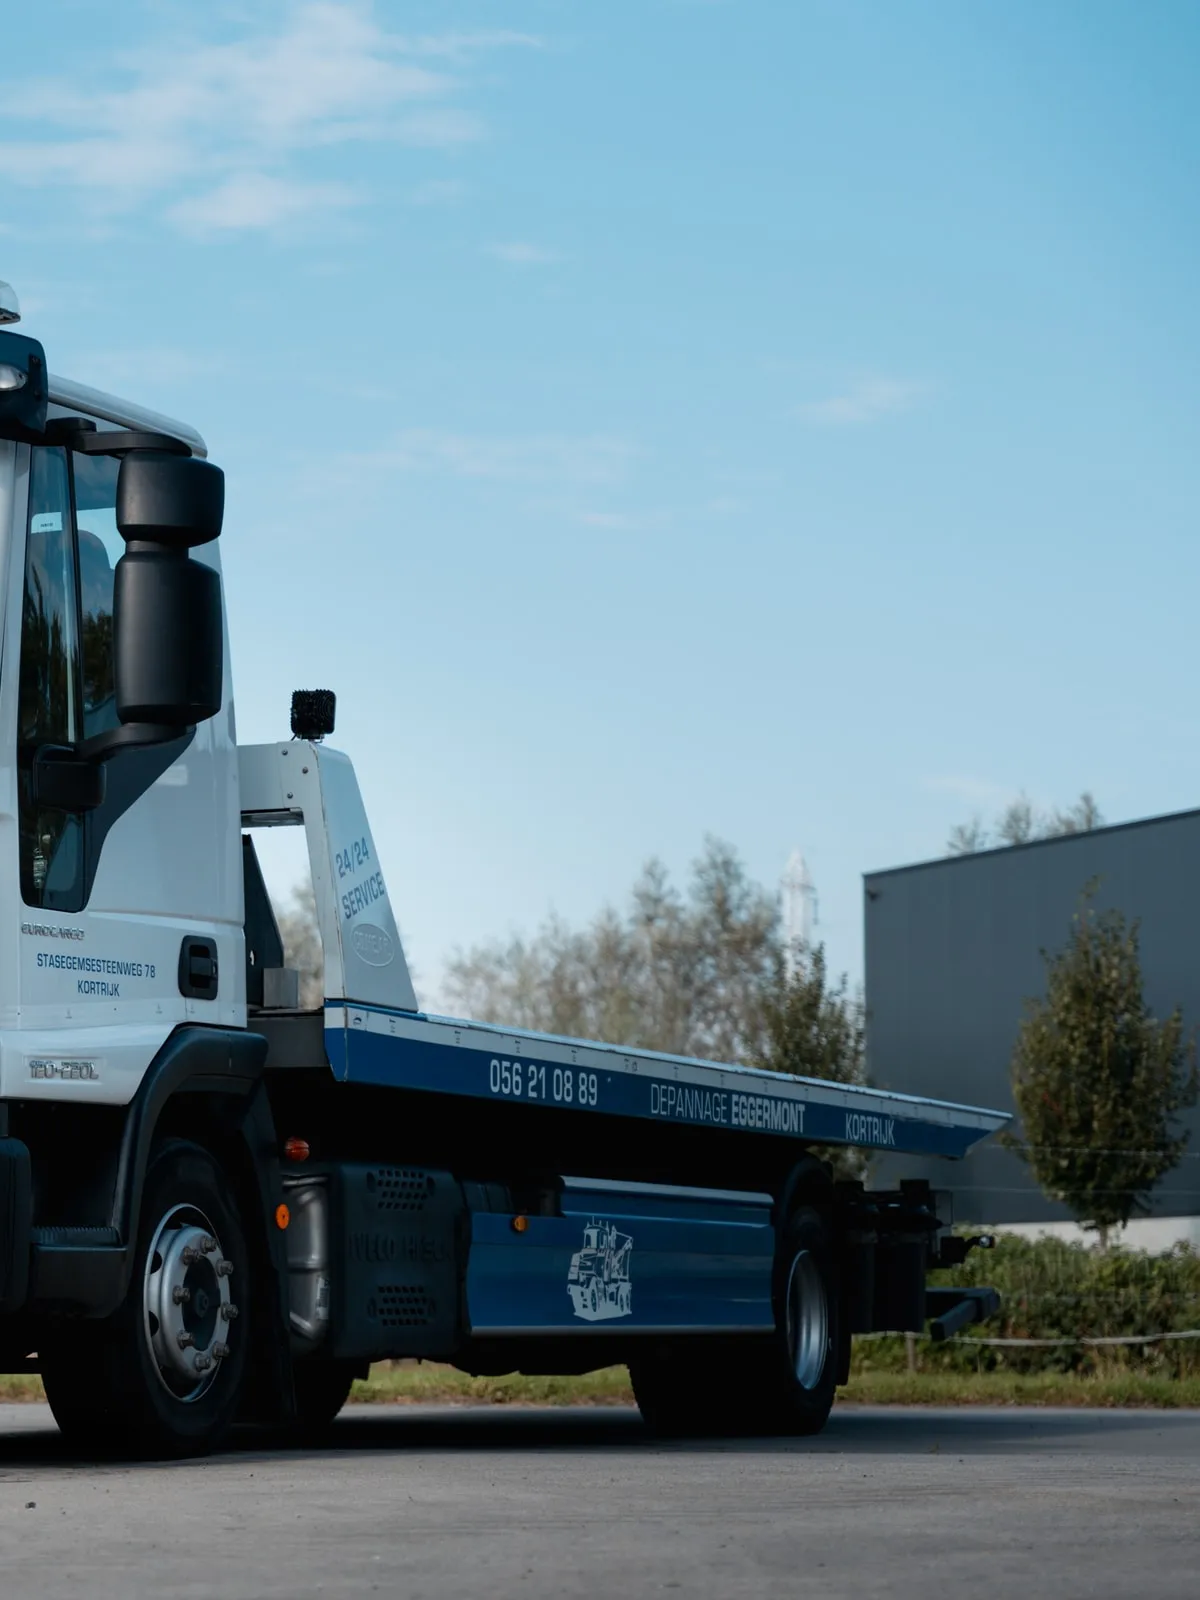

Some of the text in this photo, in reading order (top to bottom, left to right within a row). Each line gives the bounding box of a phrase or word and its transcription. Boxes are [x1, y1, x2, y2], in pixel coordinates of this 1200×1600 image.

[335, 836, 370, 878] 24/24
[341, 871, 385, 919] SERVICE
[21, 922, 85, 941] EUROCARGO
[37, 953, 156, 979] STASEGEMSESTEENWEG 78
[77, 979, 120, 997] KORTRIJK
[490, 1059, 598, 1106] 056 21 08 89
[651, 1083, 806, 1134] DEPANNAGE EGGERMONT
[845, 1112, 896, 1146] KORTRIJK
